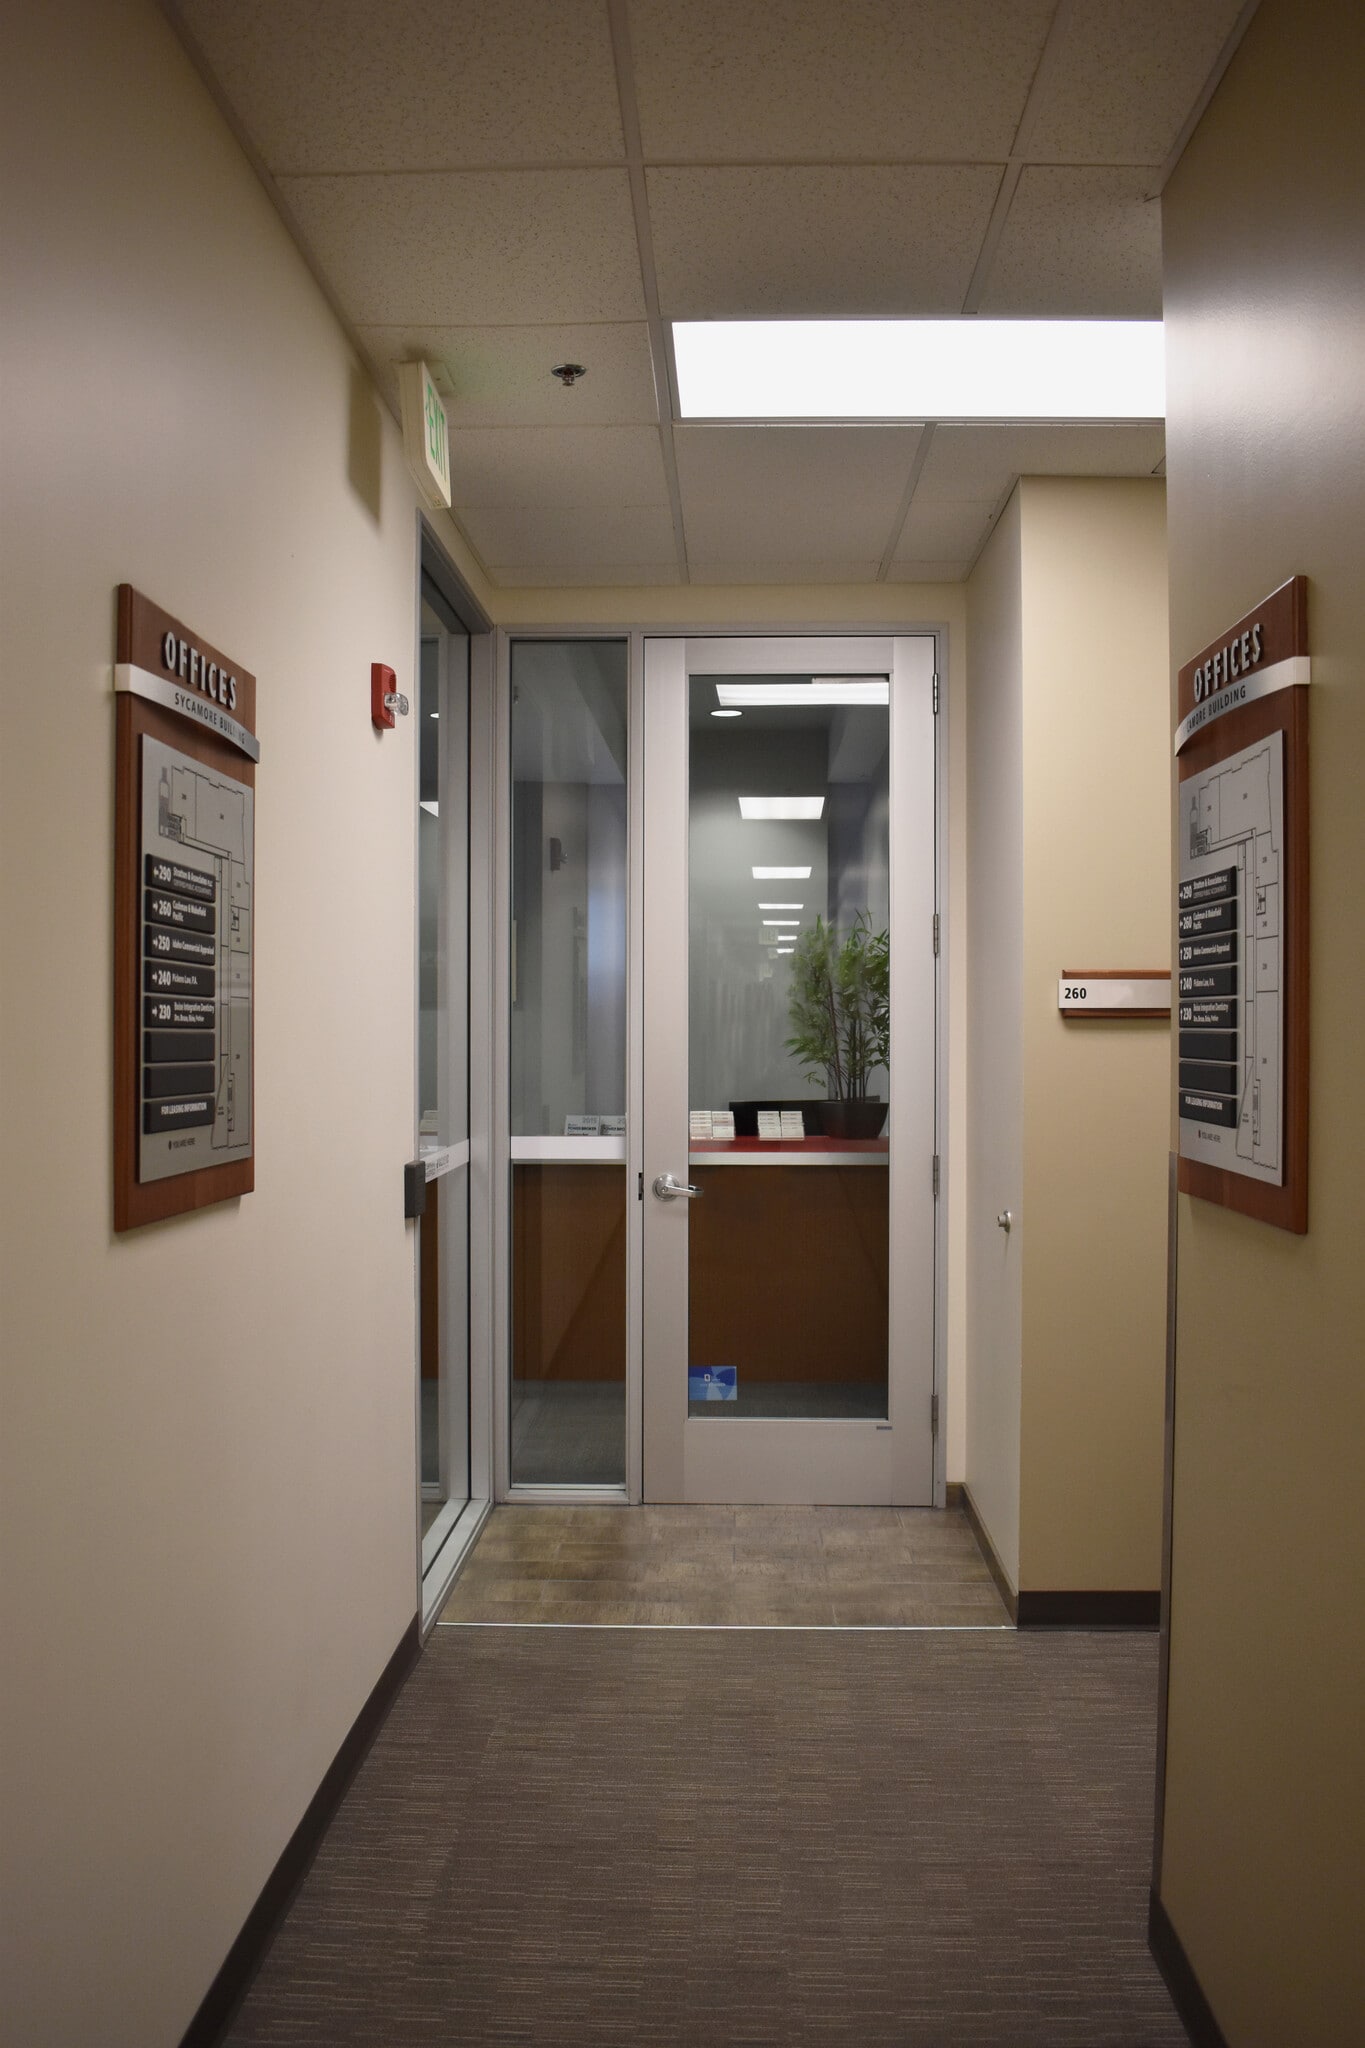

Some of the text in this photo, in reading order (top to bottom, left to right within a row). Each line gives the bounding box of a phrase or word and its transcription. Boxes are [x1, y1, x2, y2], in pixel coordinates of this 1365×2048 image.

[427, 383, 447, 482] EXIT
[164, 631, 237, 711] OFFICES
[1193, 623, 1261, 703] OFFICES
[1208, 685, 1246, 715] BUILDING
[175, 692, 217, 725] SYCAMORE
[158, 865, 172, 882] 290
[1183, 885, 1192, 899] 290
[158, 900, 172, 917] 260
[1183, 916, 1192, 930] 260
[158, 935, 170, 951] 250
[1183, 946, 1192, 960] 250
[158, 970, 171, 986] 240
[1183, 977, 1192, 991] 240
[1064, 987, 1087, 999] 260
[159, 1004, 171, 1020] 230
[1183, 1007, 1192, 1021] 230
